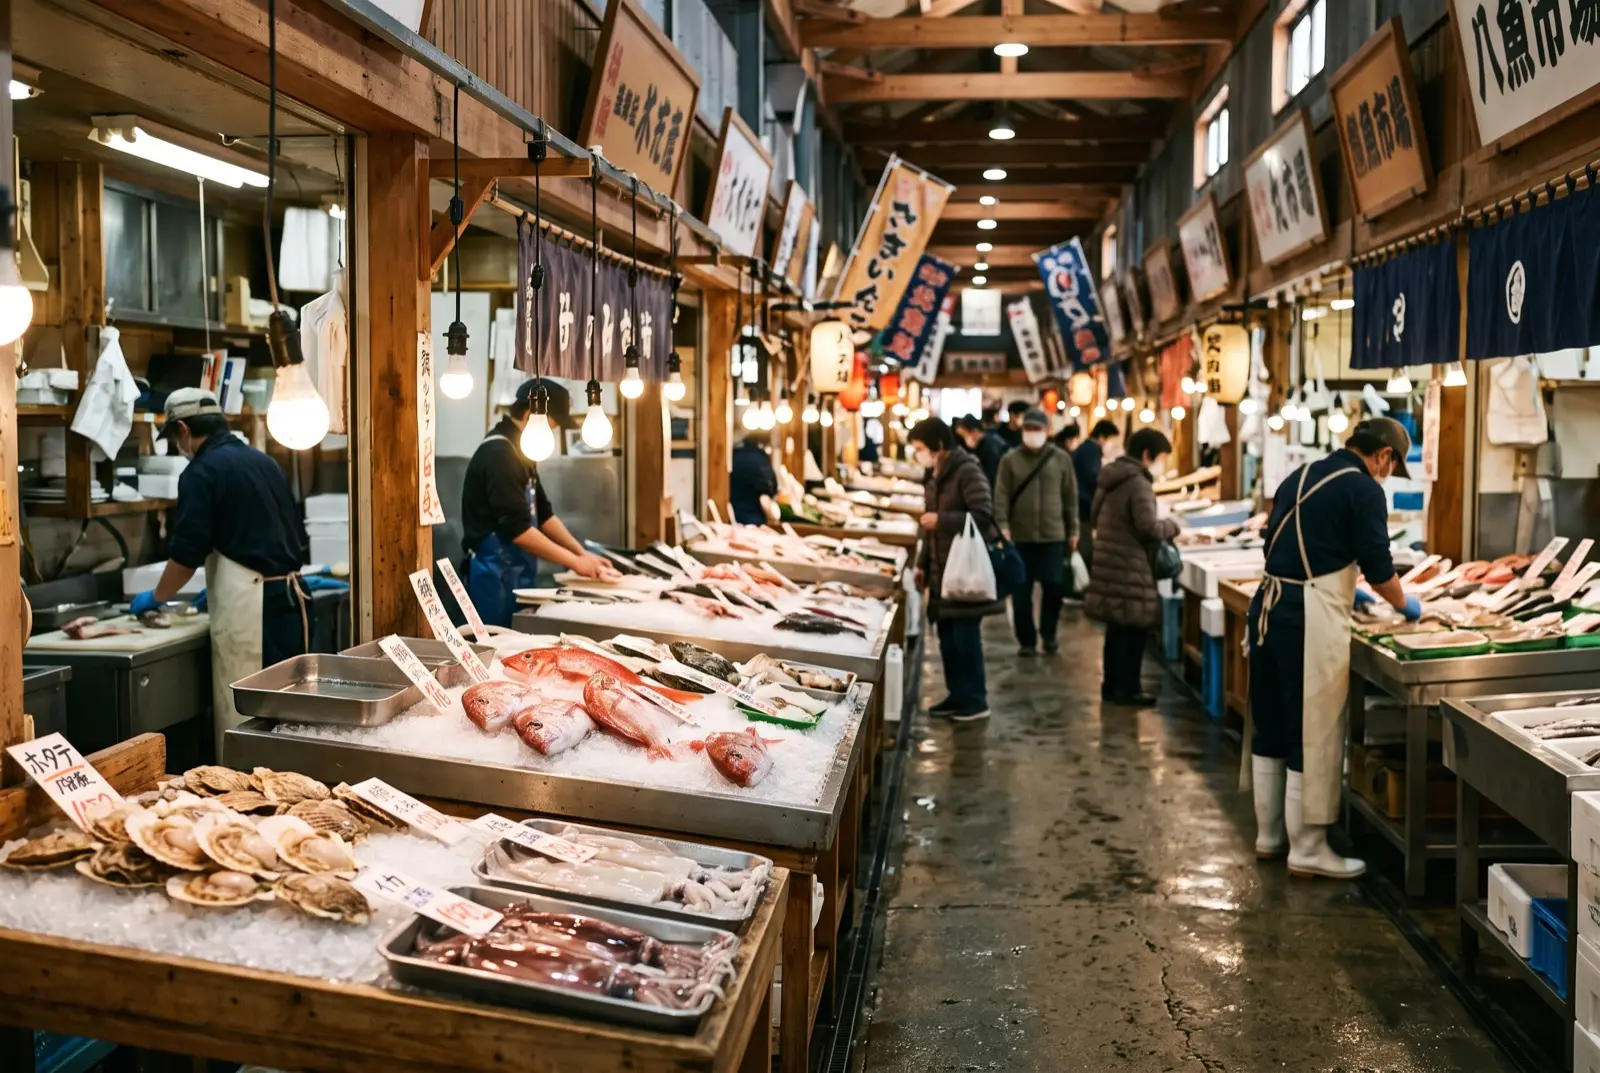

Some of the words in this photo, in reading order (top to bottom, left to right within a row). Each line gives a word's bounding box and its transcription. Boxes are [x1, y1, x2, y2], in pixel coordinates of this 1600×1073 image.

[24, 744, 71, 775] ホタテ
[374, 874, 406, 894] イカ
